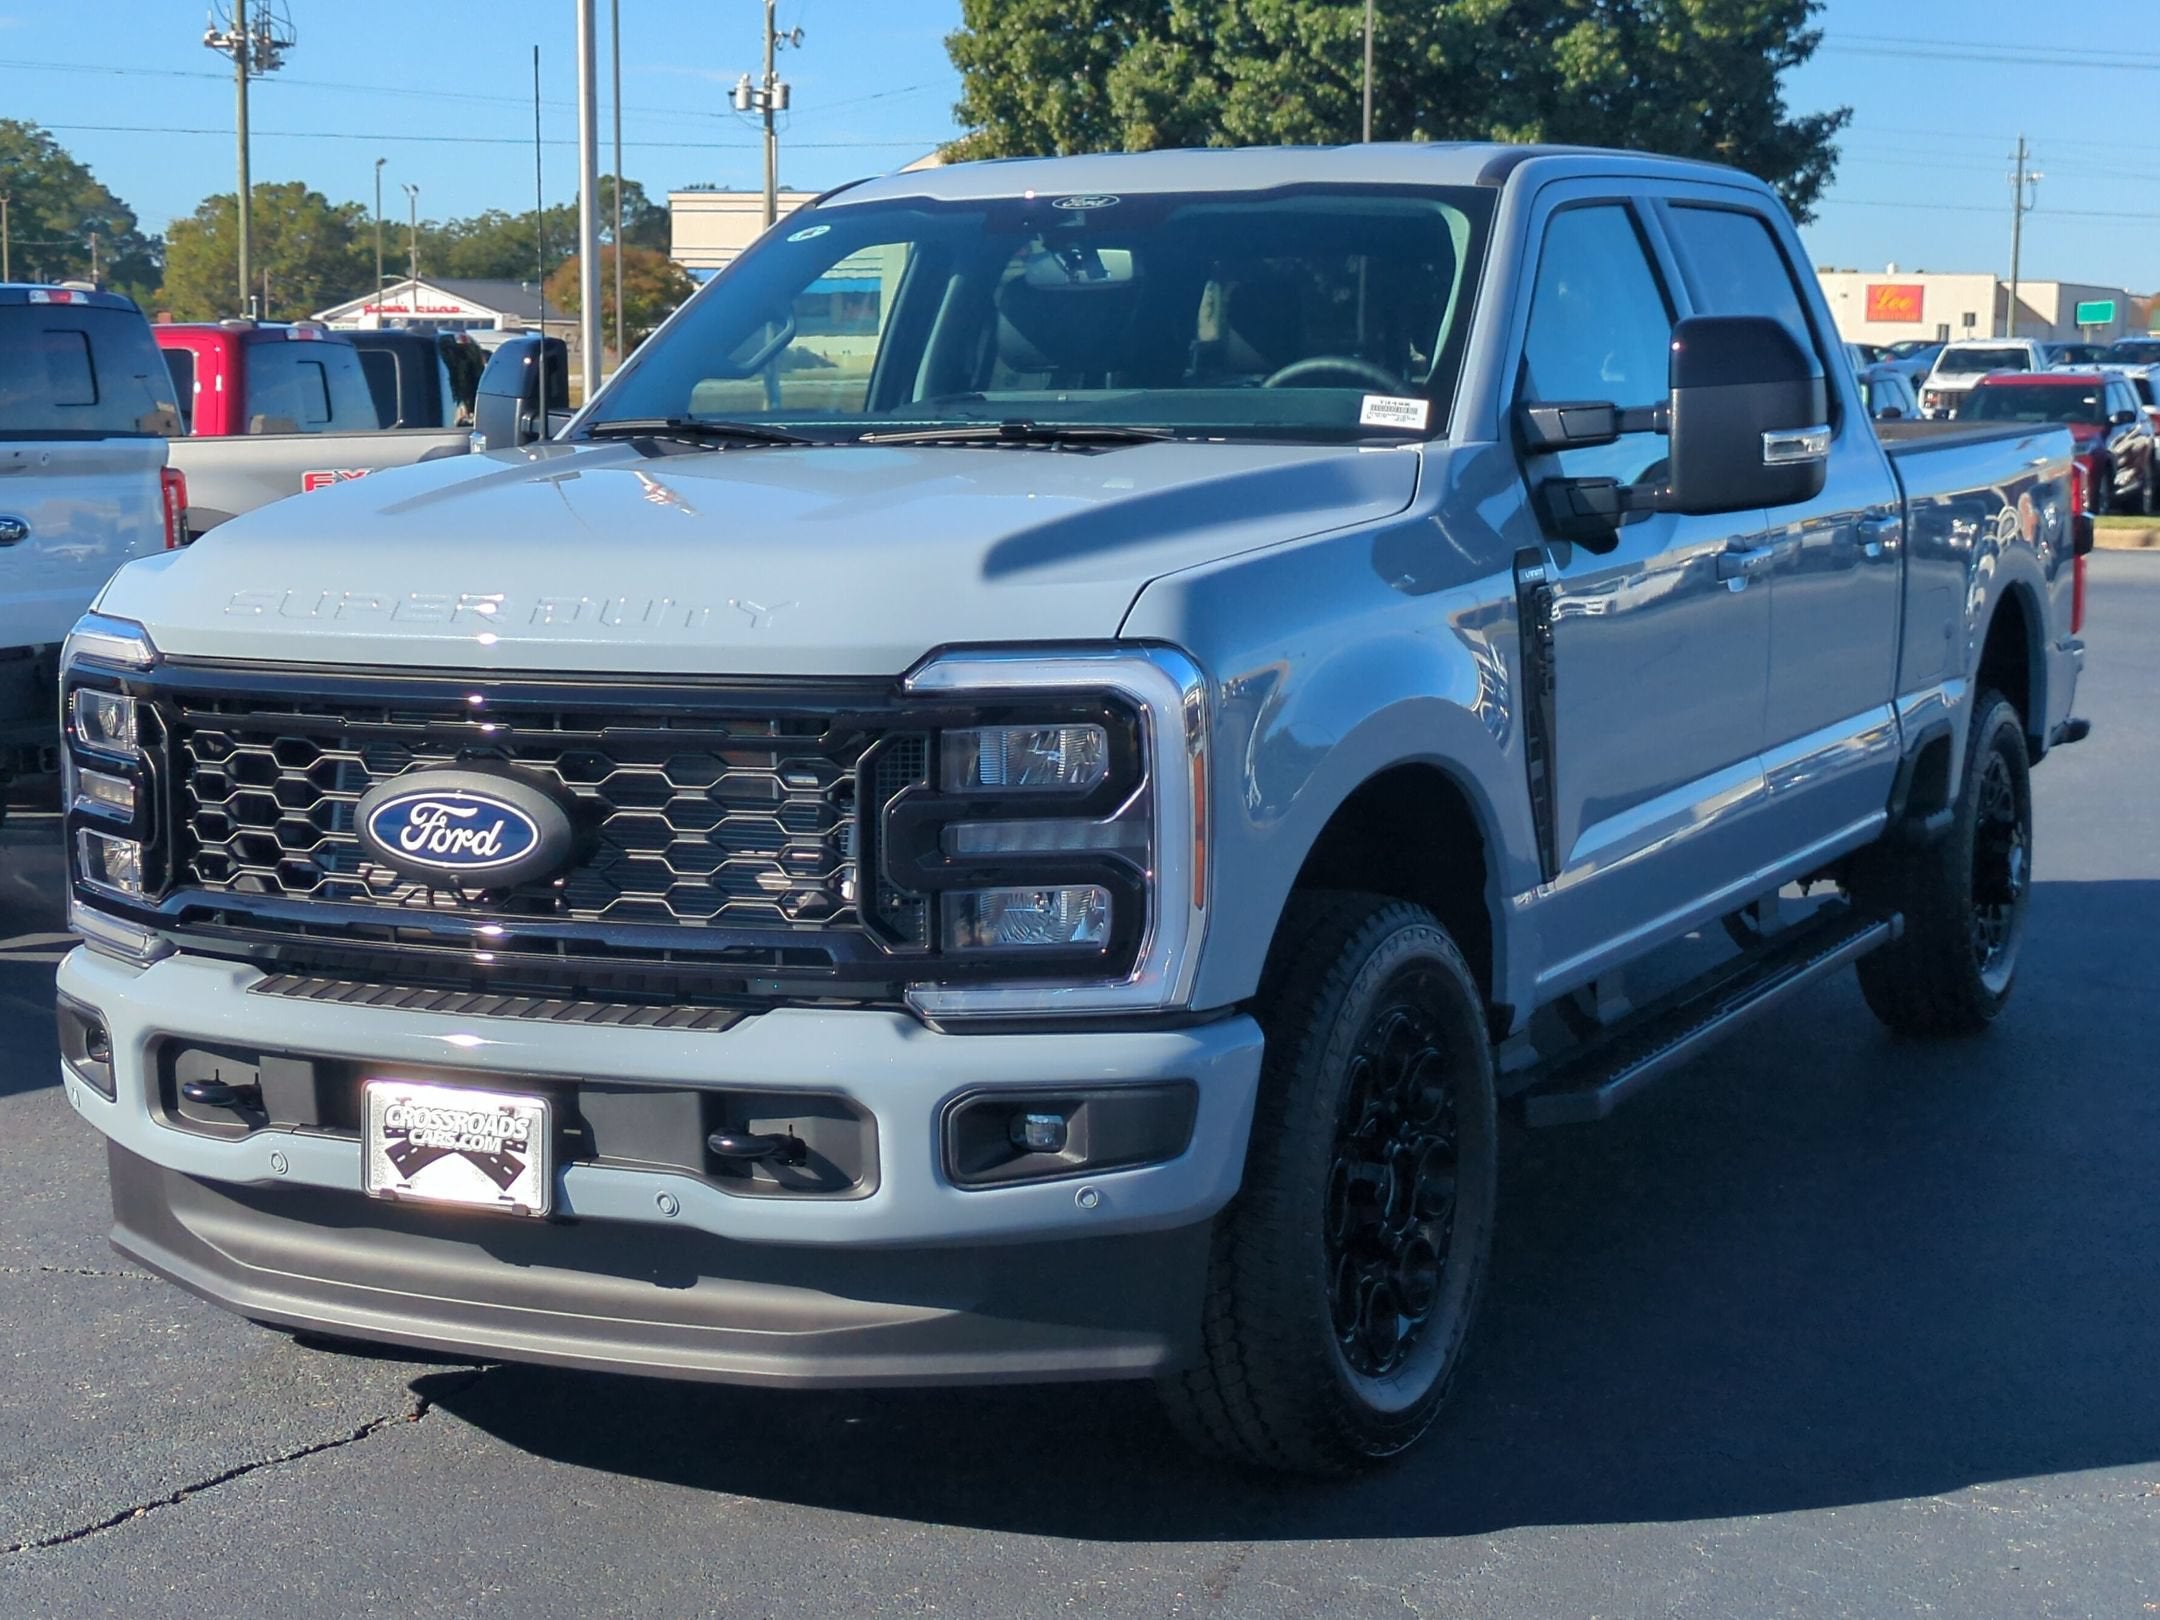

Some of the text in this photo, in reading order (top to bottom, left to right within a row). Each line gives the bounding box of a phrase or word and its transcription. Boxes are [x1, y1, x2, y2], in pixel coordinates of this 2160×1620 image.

[224, 590, 800, 629] SUPER DUTY
[400, 802, 504, 856] Ford
[385, 1104, 531, 1141] CROSSROADS
[409, 1128, 502, 1155] CARS.COM
